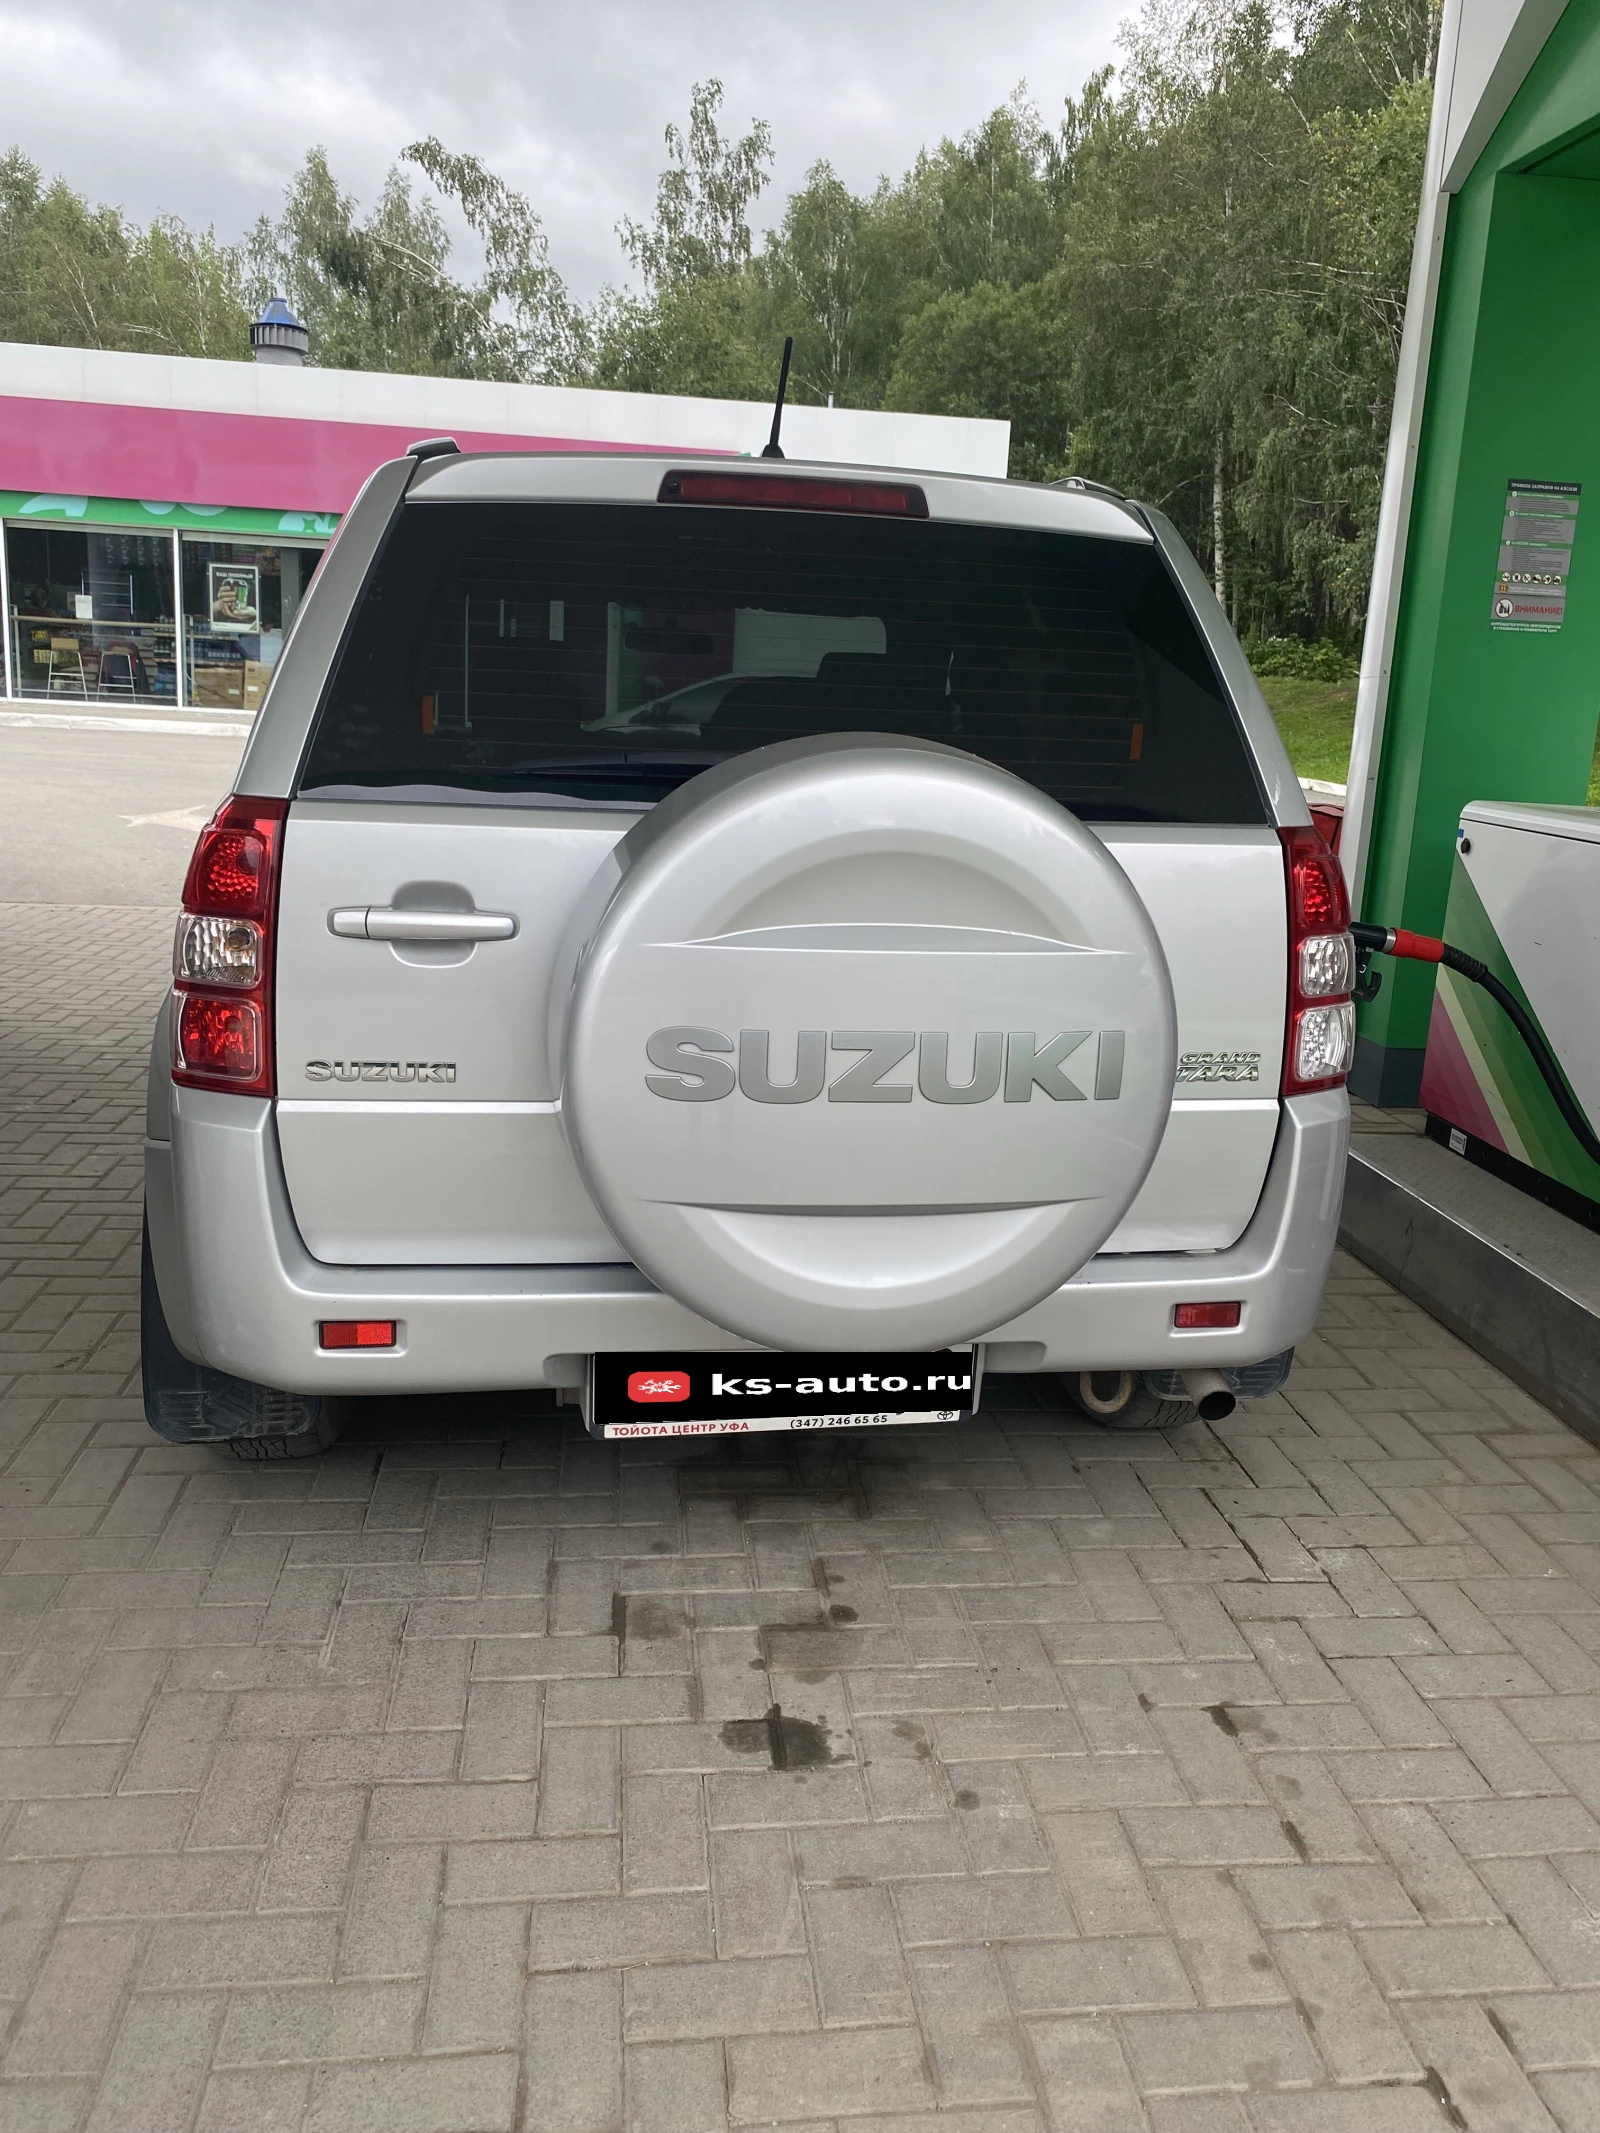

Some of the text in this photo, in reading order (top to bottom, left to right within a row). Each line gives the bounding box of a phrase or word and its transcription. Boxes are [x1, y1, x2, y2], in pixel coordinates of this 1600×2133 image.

[1514, 605, 1563, 615] ВНИМАНИЕ!
[645, 1026, 1125, 1104] SUZUKI
[1180, 1052, 1261, 1064] GRAND
[305, 1059, 456, 1083] SUZUKI
[1176, 1064, 1259, 1082] TARA
[613, 1414, 888, 1437] ТОЙОТА ЦЕНТР УФА (347) 246 65 65
